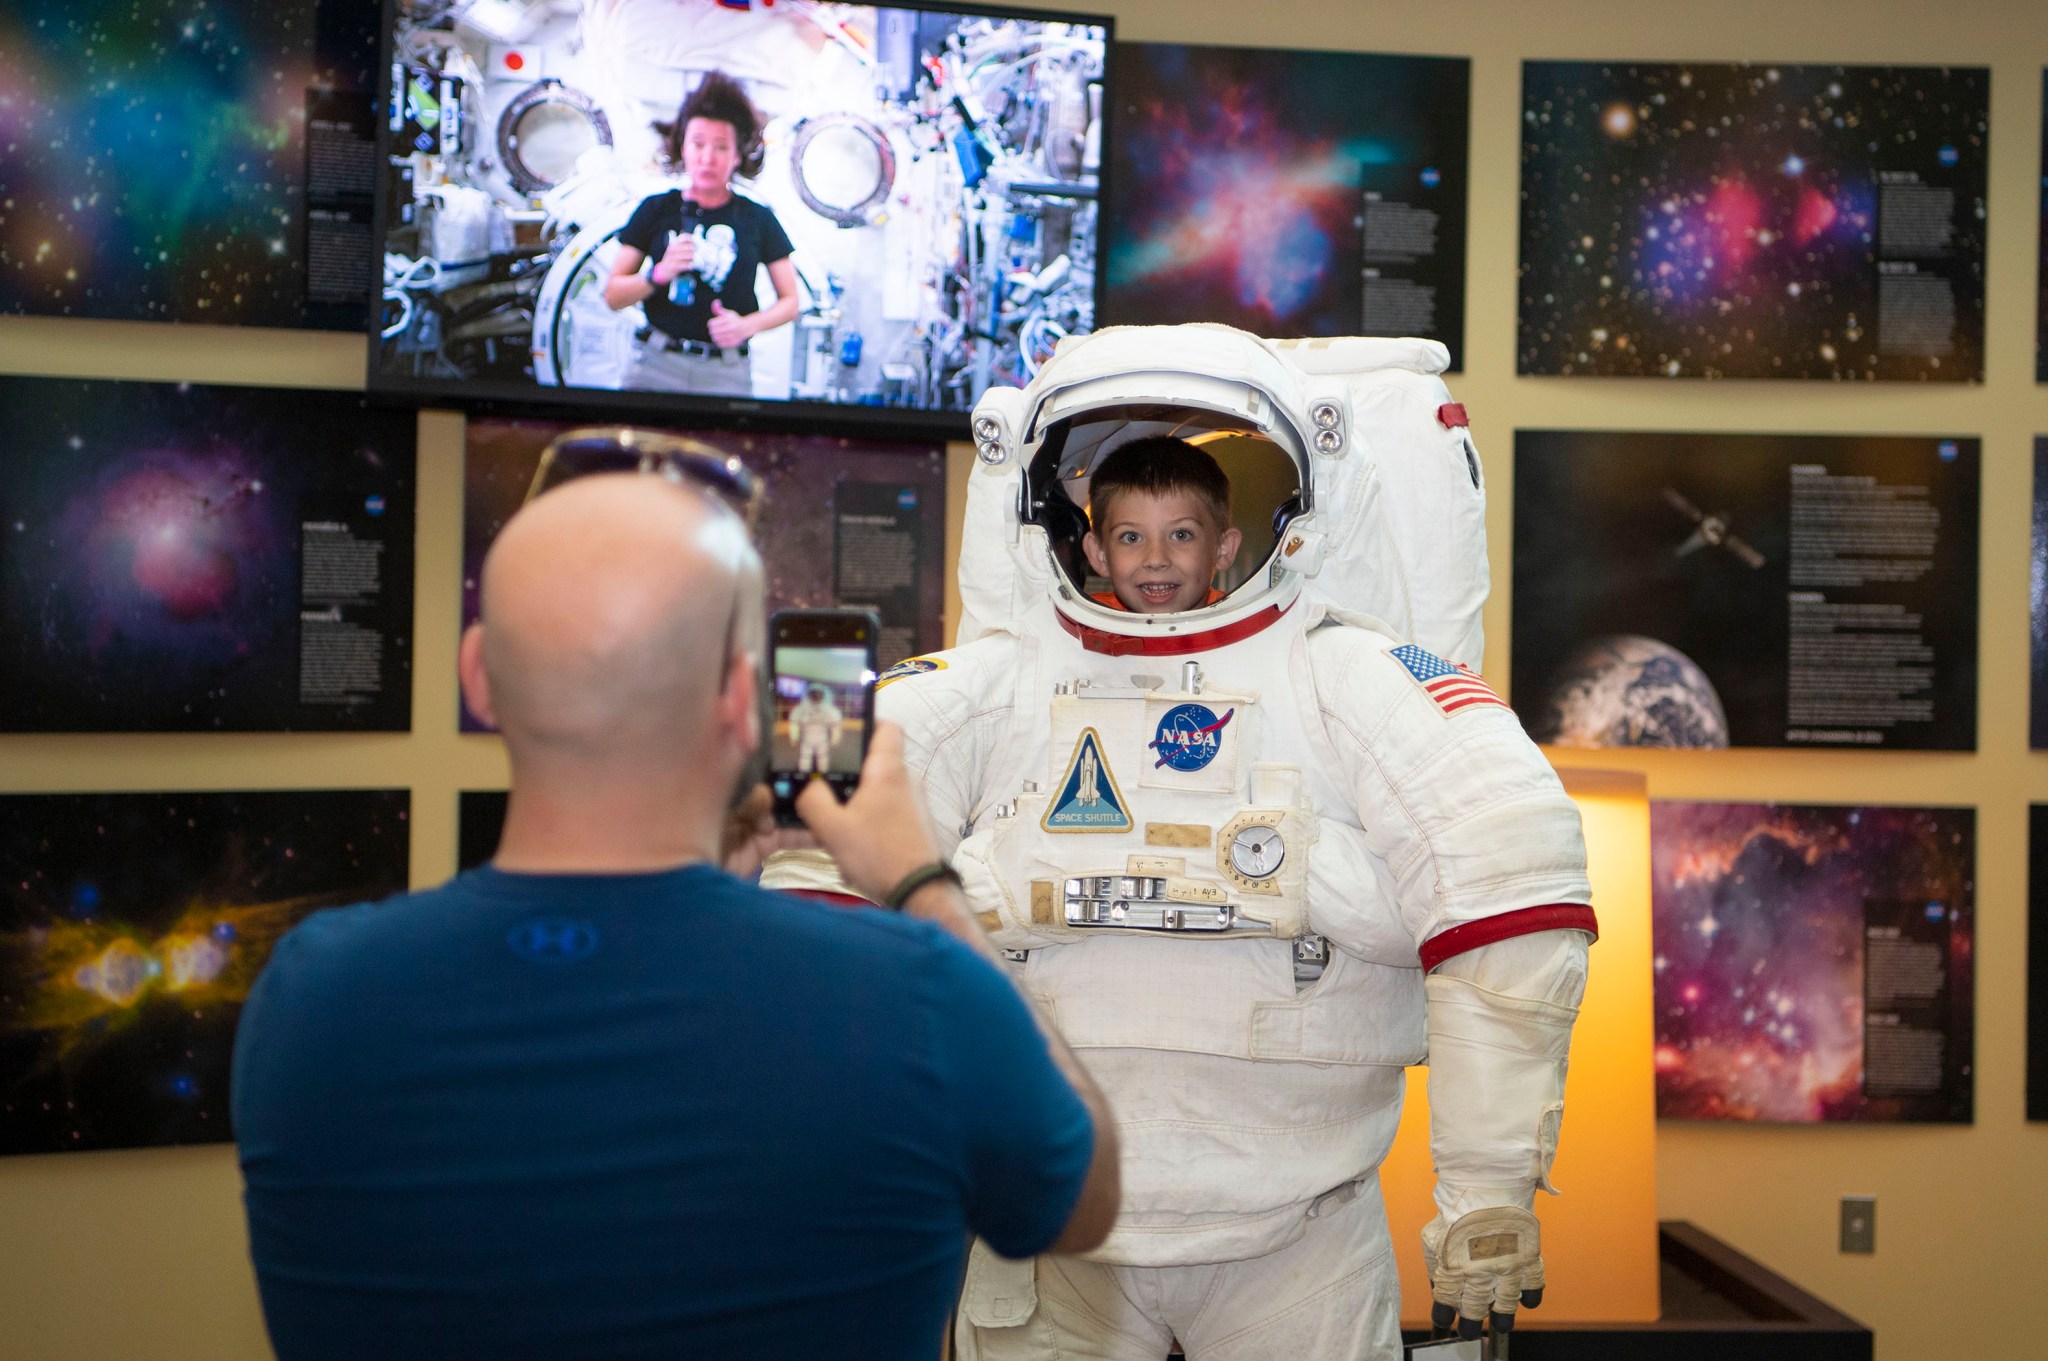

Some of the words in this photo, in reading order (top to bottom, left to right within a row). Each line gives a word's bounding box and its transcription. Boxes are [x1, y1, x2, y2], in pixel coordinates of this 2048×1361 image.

[1161, 728, 1217, 747] NASA
[1054, 813, 1082, 823] SPACE
[1085, 813, 1121, 823] SHUTTLE
